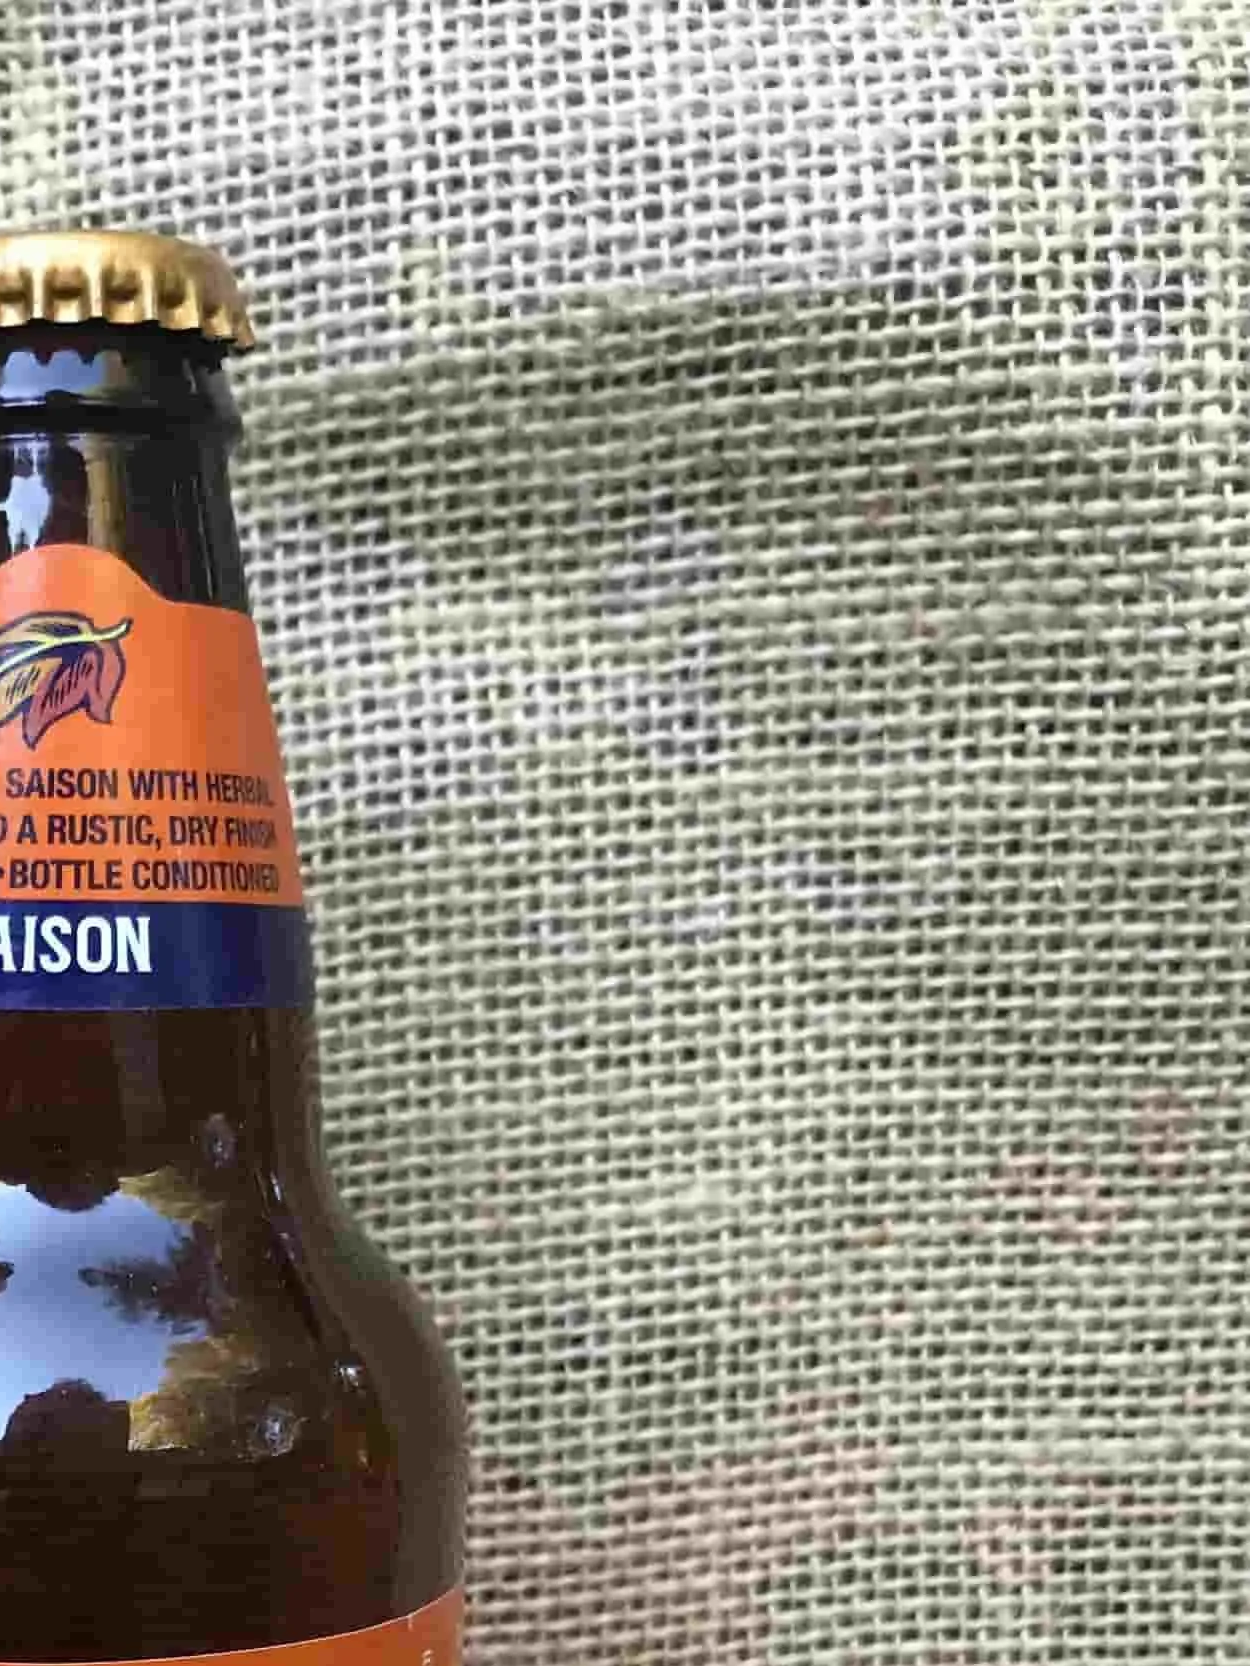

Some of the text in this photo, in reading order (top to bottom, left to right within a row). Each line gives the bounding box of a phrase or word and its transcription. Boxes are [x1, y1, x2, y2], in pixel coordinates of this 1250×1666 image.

[6, 768, 117, 799] SAISON
[128, 768, 199, 800] WITH
[16, 814, 38, 844] A
[47, 815, 161, 850] RUSTIC,
[170, 816, 217, 847] DRY
[132, 860, 279, 894] CONDITIONED
